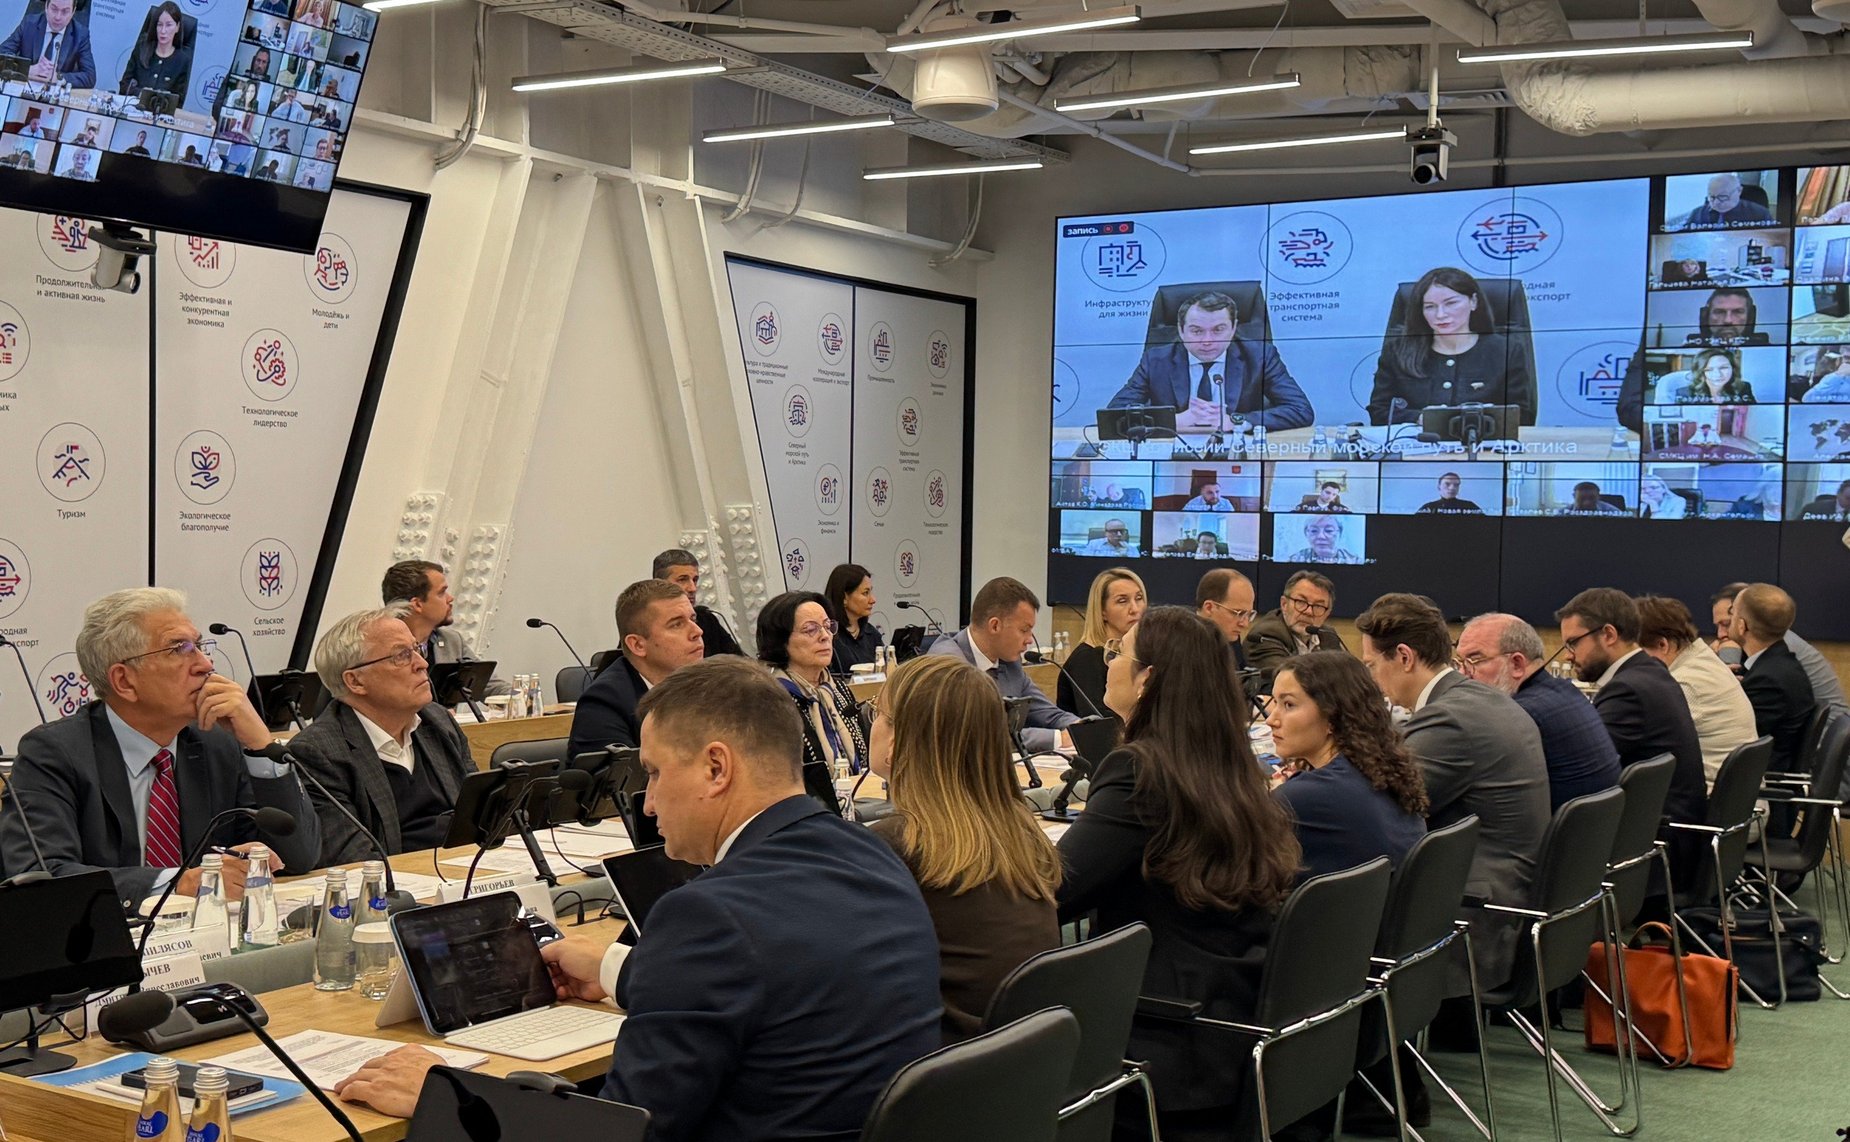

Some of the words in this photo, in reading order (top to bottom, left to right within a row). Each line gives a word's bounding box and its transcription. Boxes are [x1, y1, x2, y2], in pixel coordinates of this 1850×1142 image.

[1067, 227, 1099, 236] запись
[44, 290, 80, 300] активная
[81, 294, 106, 303] жизнь
[179, 291, 227, 305] Эффективная
[1269, 291, 1341, 301] Эффективная
[181, 305, 231, 317] конкурентная
[1269, 302, 1341, 312] транспортная
[312, 308, 345, 320] Молодёжь
[1098, 311, 1116, 319] для
[1117, 309, 1149, 318] жизни
[1281, 313, 1324, 322] система
[187, 317, 225, 329] экономика
[242, 405, 299, 418] Технологическое
[253, 419, 288, 429] лидерство
[1231, 440, 1327, 457] Северный
[1333, 442, 1414, 456] морской
[1423, 443, 1466, 457] путь
[1471, 443, 1485, 454] и
[1491, 441, 1578, 456] Арктика
[57, 509, 86, 520] Туризм
[179, 510, 231, 521] Экологическое
[180, 522, 230, 533] благополучие
[254, 616, 285, 625] Сельское
[252, 627, 286, 637] хозяйство
